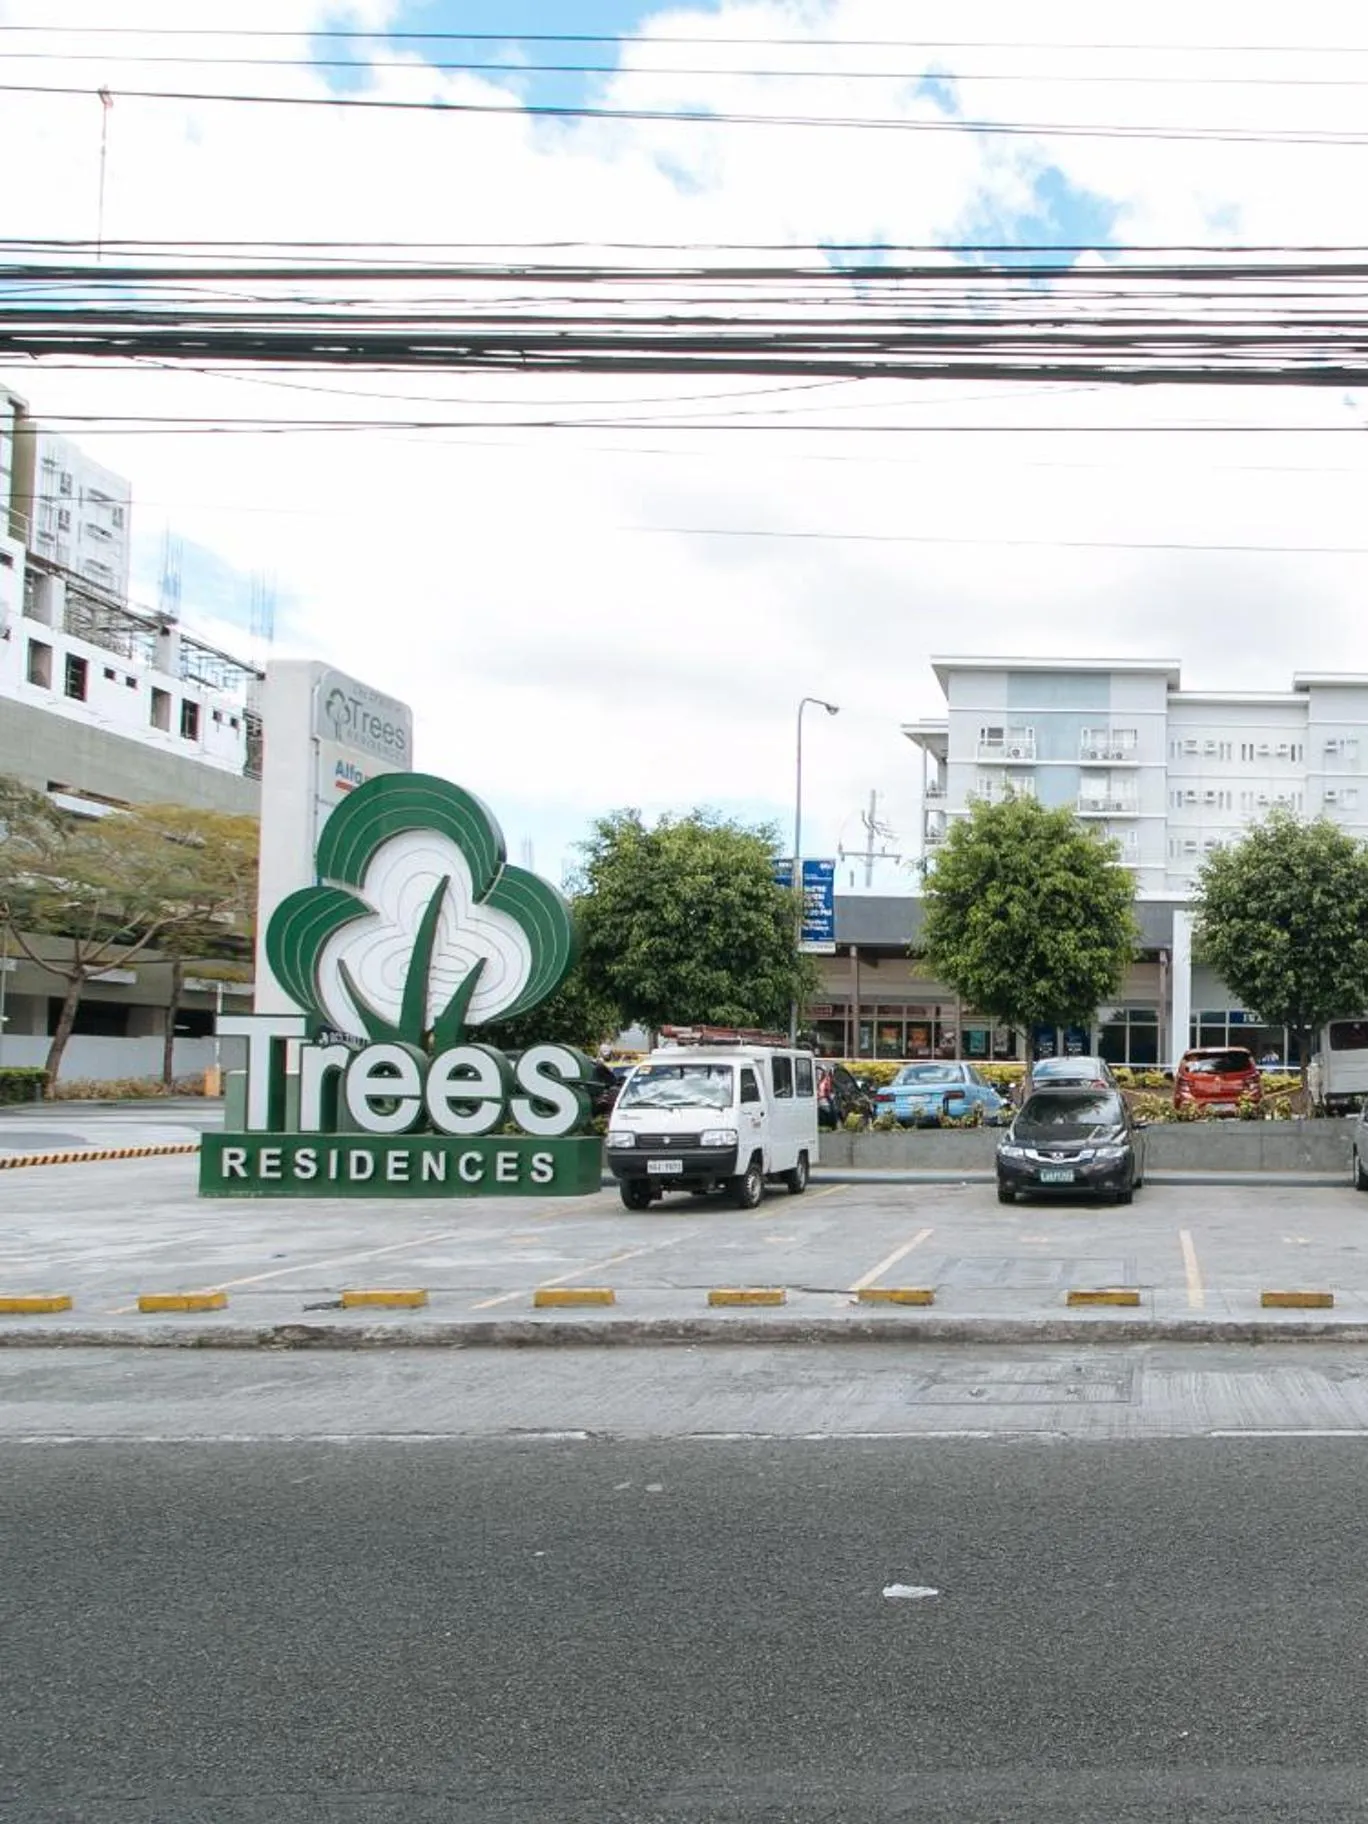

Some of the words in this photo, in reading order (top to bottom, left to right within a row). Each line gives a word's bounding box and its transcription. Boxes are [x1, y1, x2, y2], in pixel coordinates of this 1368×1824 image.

[348, 697, 405, 750] Trees
[335, 760, 371, 785] Alfa
[216, 1017, 581, 1136] Trees
[221, 1147, 555, 1183] RESIDENCES
